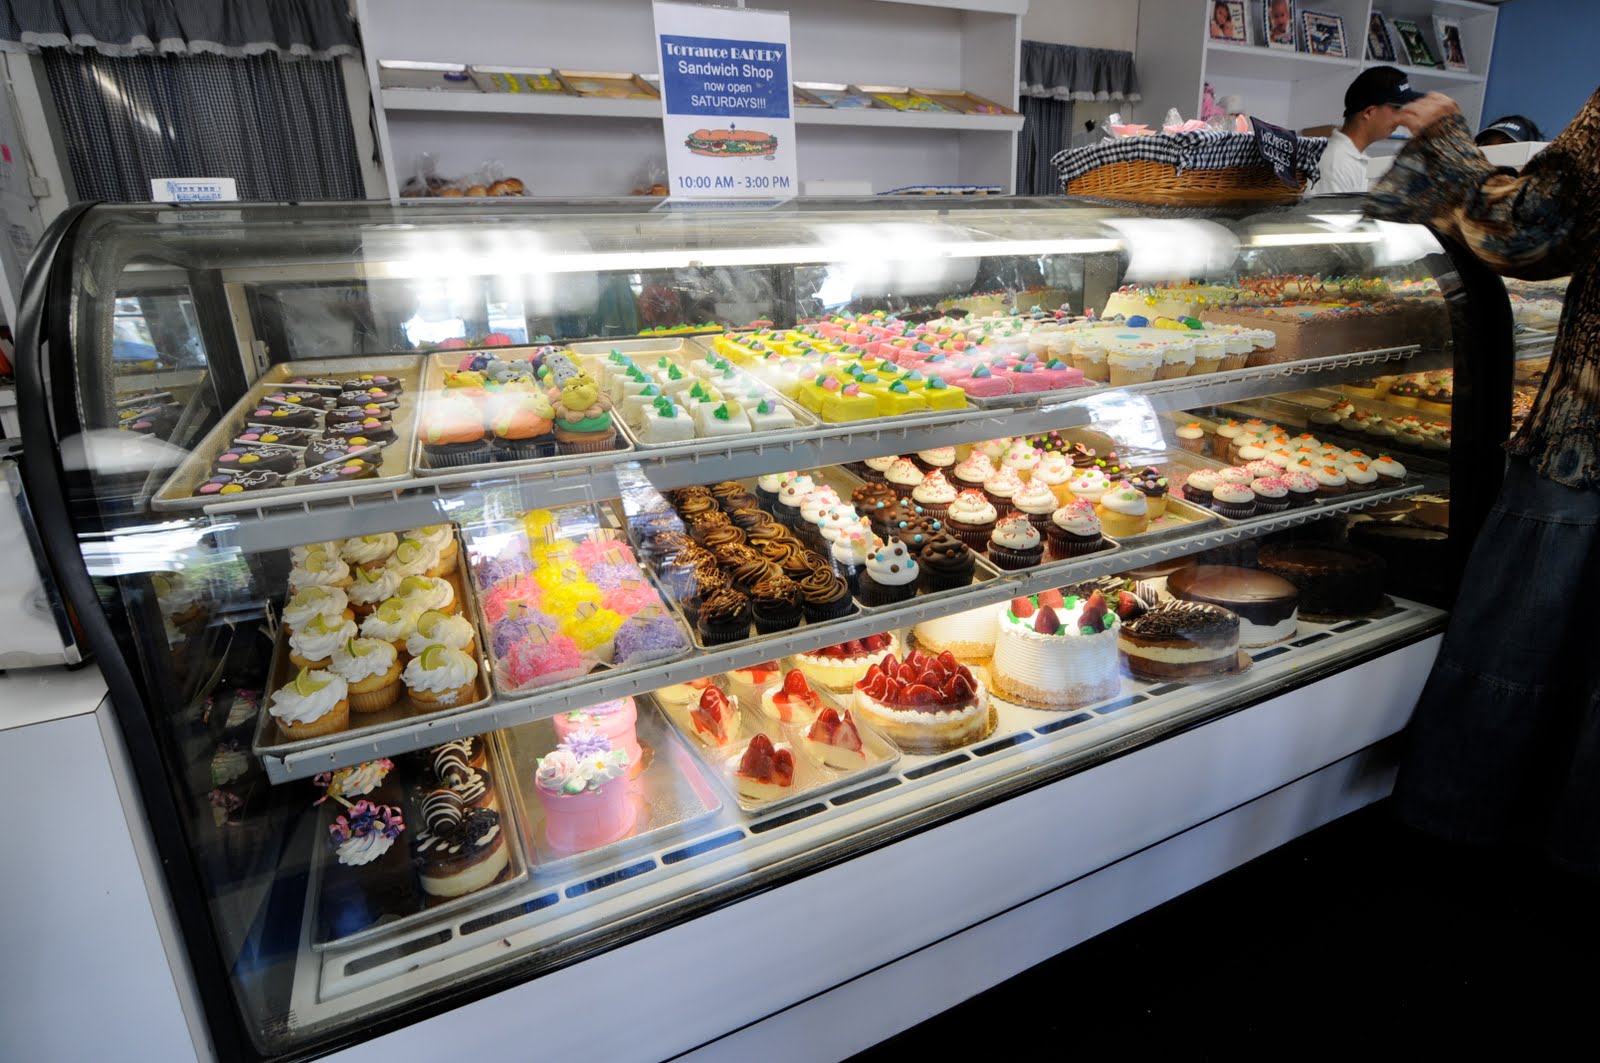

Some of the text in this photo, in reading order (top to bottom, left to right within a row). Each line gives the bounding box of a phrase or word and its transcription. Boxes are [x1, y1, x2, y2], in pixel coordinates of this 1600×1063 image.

[665, 42, 784, 62] Torrance BAKERY
[678, 60, 774, 81] Sandwich Shop
[703, 82, 752, 95] now open
[691, 95, 766, 109] SATURDAYS!!!
[678, 175, 711, 188] 10:00
[714, 176, 734, 188] AM
[745, 176, 769, 188] 3:00
[773, 176, 790, 188] PM
